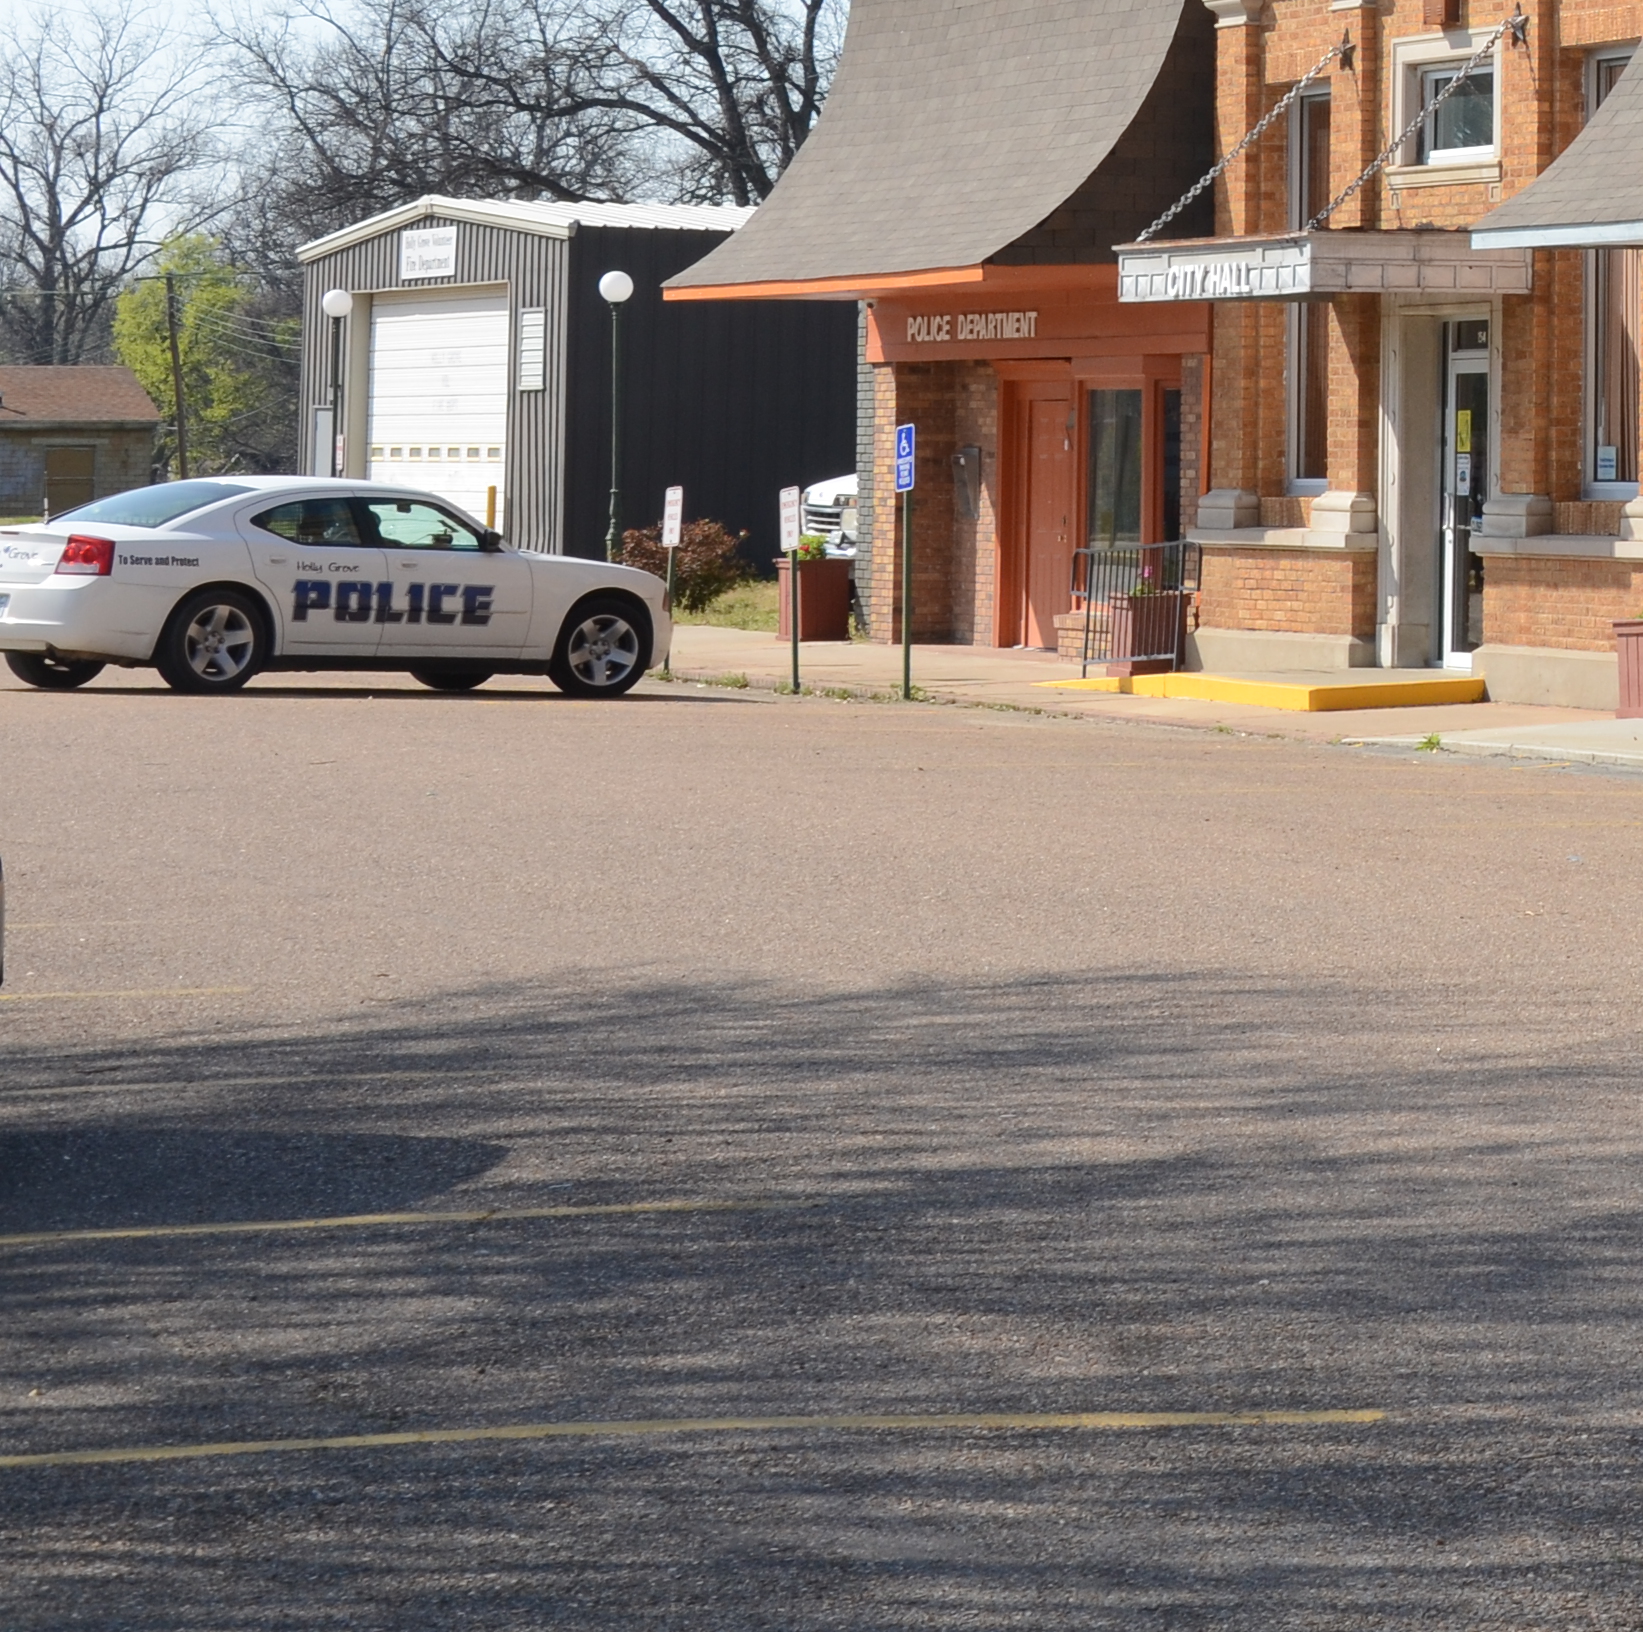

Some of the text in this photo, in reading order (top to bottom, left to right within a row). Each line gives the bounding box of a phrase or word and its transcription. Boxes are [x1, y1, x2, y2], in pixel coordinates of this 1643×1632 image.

[1167, 261, 1250, 297] CITY HALL
[906, 311, 1038, 342] POLICE DEPARTMENT
[118, 554, 200, 567] To Serve and Protect
[297, 561, 360, 574] Holly Grove
[291, 579, 496, 627] POLICE
